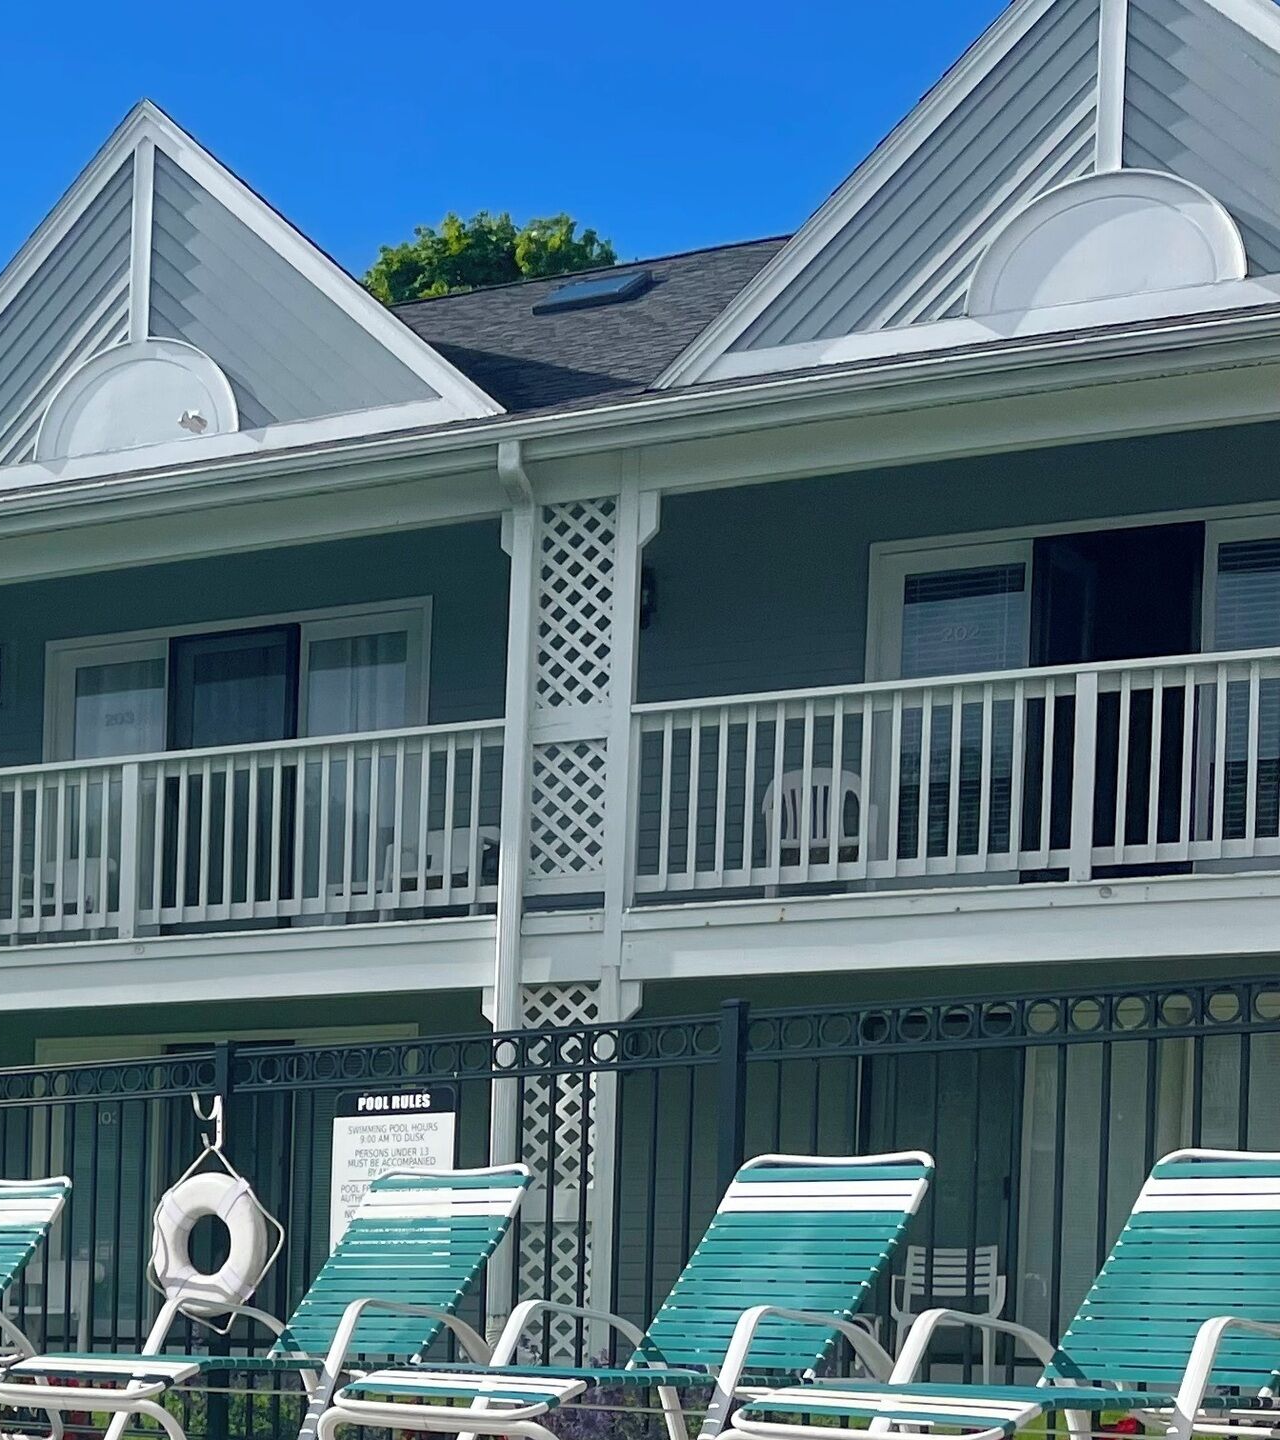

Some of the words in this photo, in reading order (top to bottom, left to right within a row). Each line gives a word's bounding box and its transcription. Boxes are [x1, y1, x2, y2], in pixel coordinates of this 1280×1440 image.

[357, 1096, 390, 1111] POOL
[391, 1094, 431, 1109] RULES
[348, 1124, 387, 1135] SWIMMING
[389, 1123, 409, 1133] POOL
[411, 1122, 438, 1132] HOURS
[379, 1134, 389, 1143] AM
[392, 1133, 402, 1142] TO
[404, 1133, 425, 1142] DUSK
[355, 1148, 389, 1158] PERSONS
[391, 1147, 417, 1157] UNDER
[348, 1159, 368, 1168] MUST
[370, 1159, 379, 1167] BE
[381, 1157, 437, 1167] ACCOMPANIED
[340, 1184, 360, 1194] POOL
